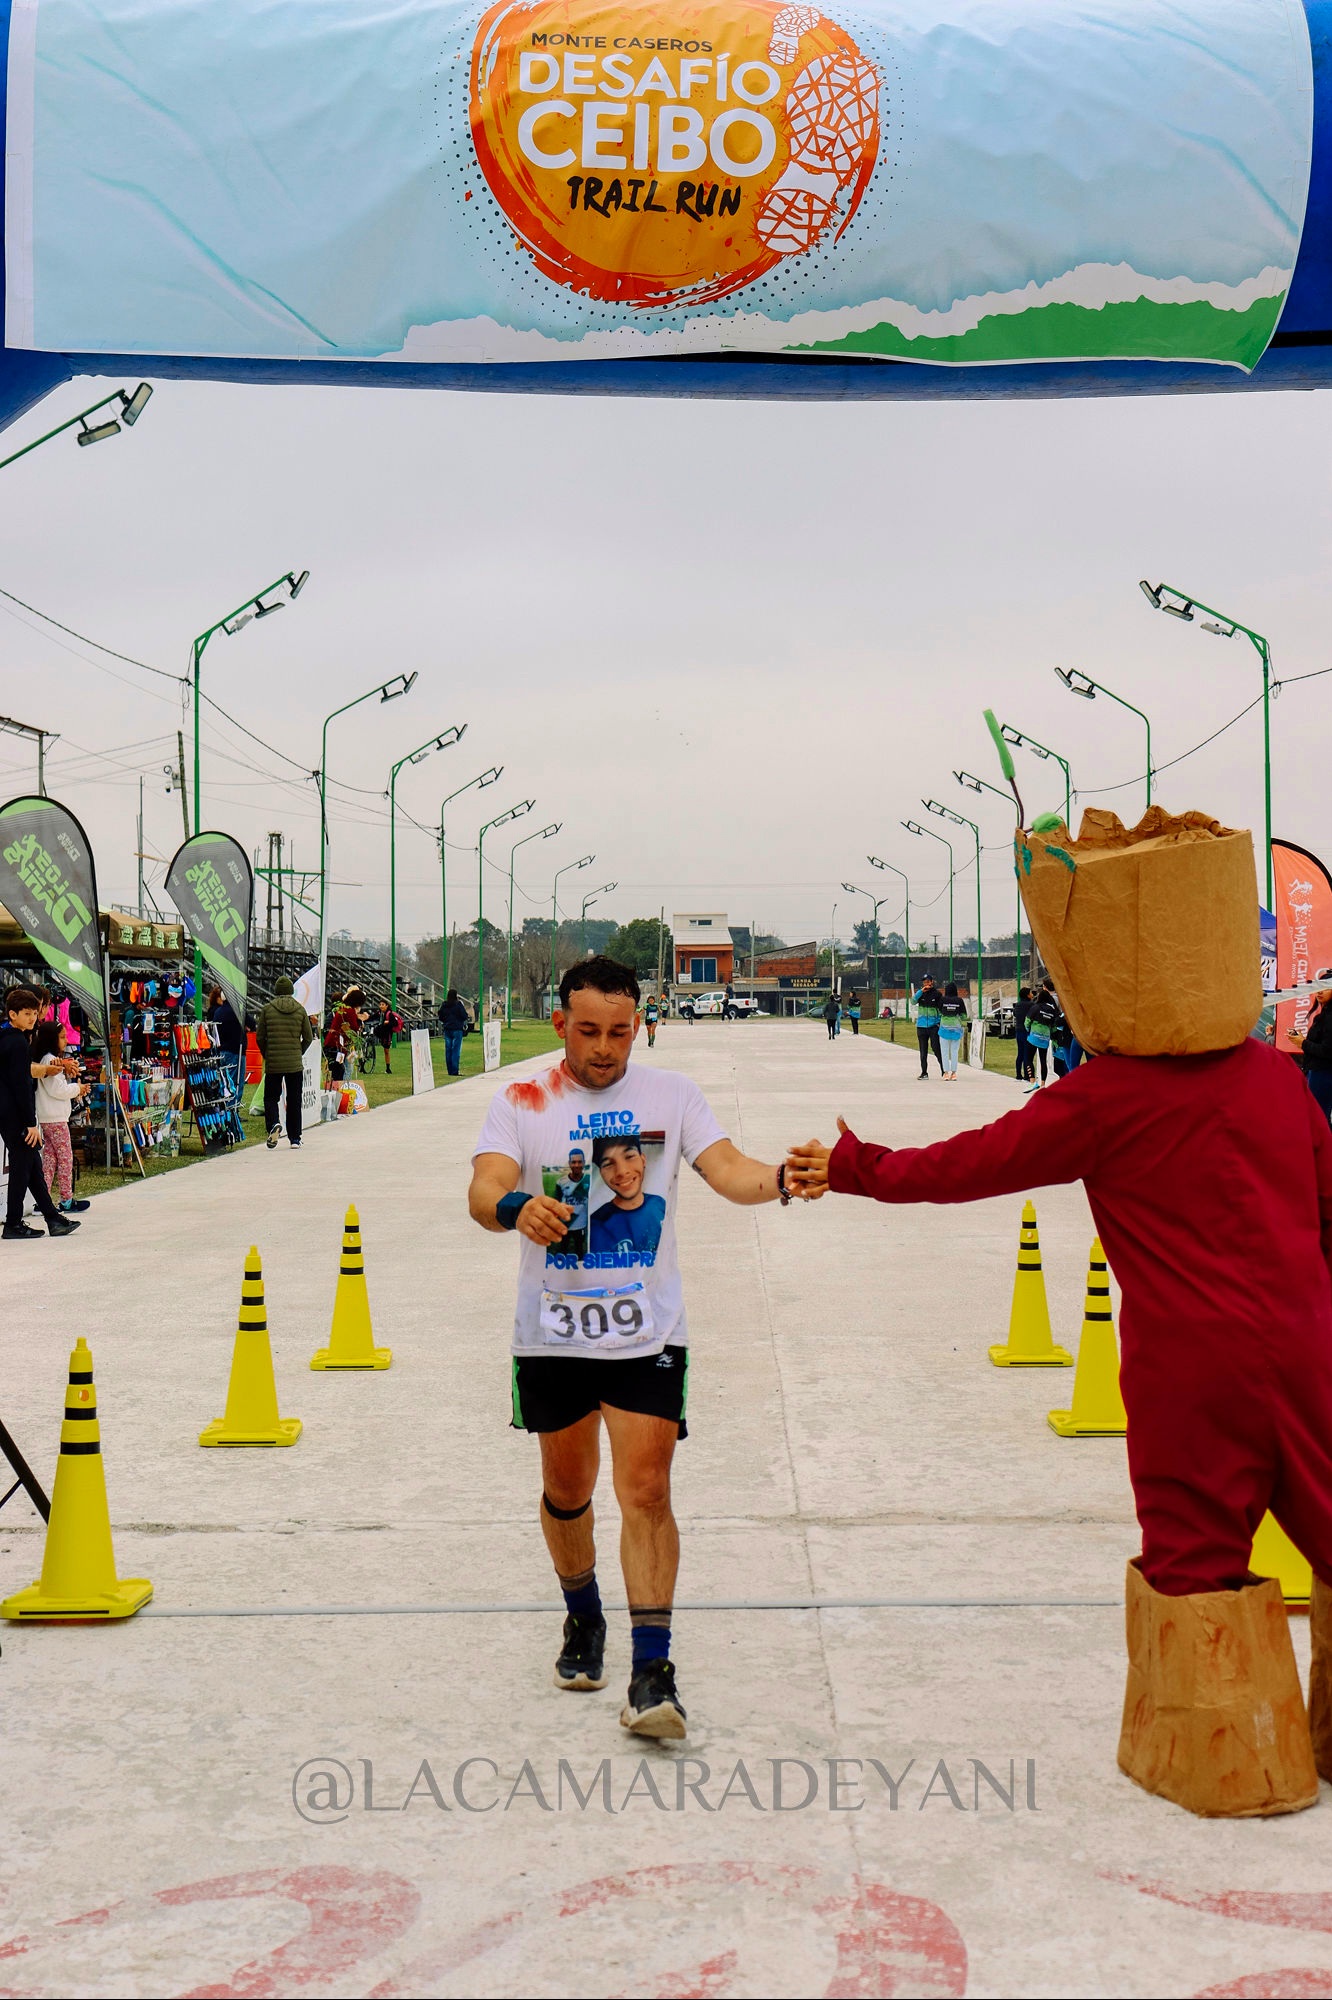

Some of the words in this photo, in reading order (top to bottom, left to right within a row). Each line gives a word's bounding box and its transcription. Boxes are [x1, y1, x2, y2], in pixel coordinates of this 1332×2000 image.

[531, 32, 607, 49] MONTE
[613, 37, 713, 53] CASEROS
[519, 51, 781, 105] DESAFÍO
[517, 100, 776, 178] CEIBO
[567, 175, 667, 218] TRAIL
[676, 180, 741, 222] RUN
[569, 1124, 641, 1141] MARTINEZ
[577, 1110, 634, 1129] LEITO
[545, 1253, 579, 1270] POR
[550, 1299, 644, 1340] 309
